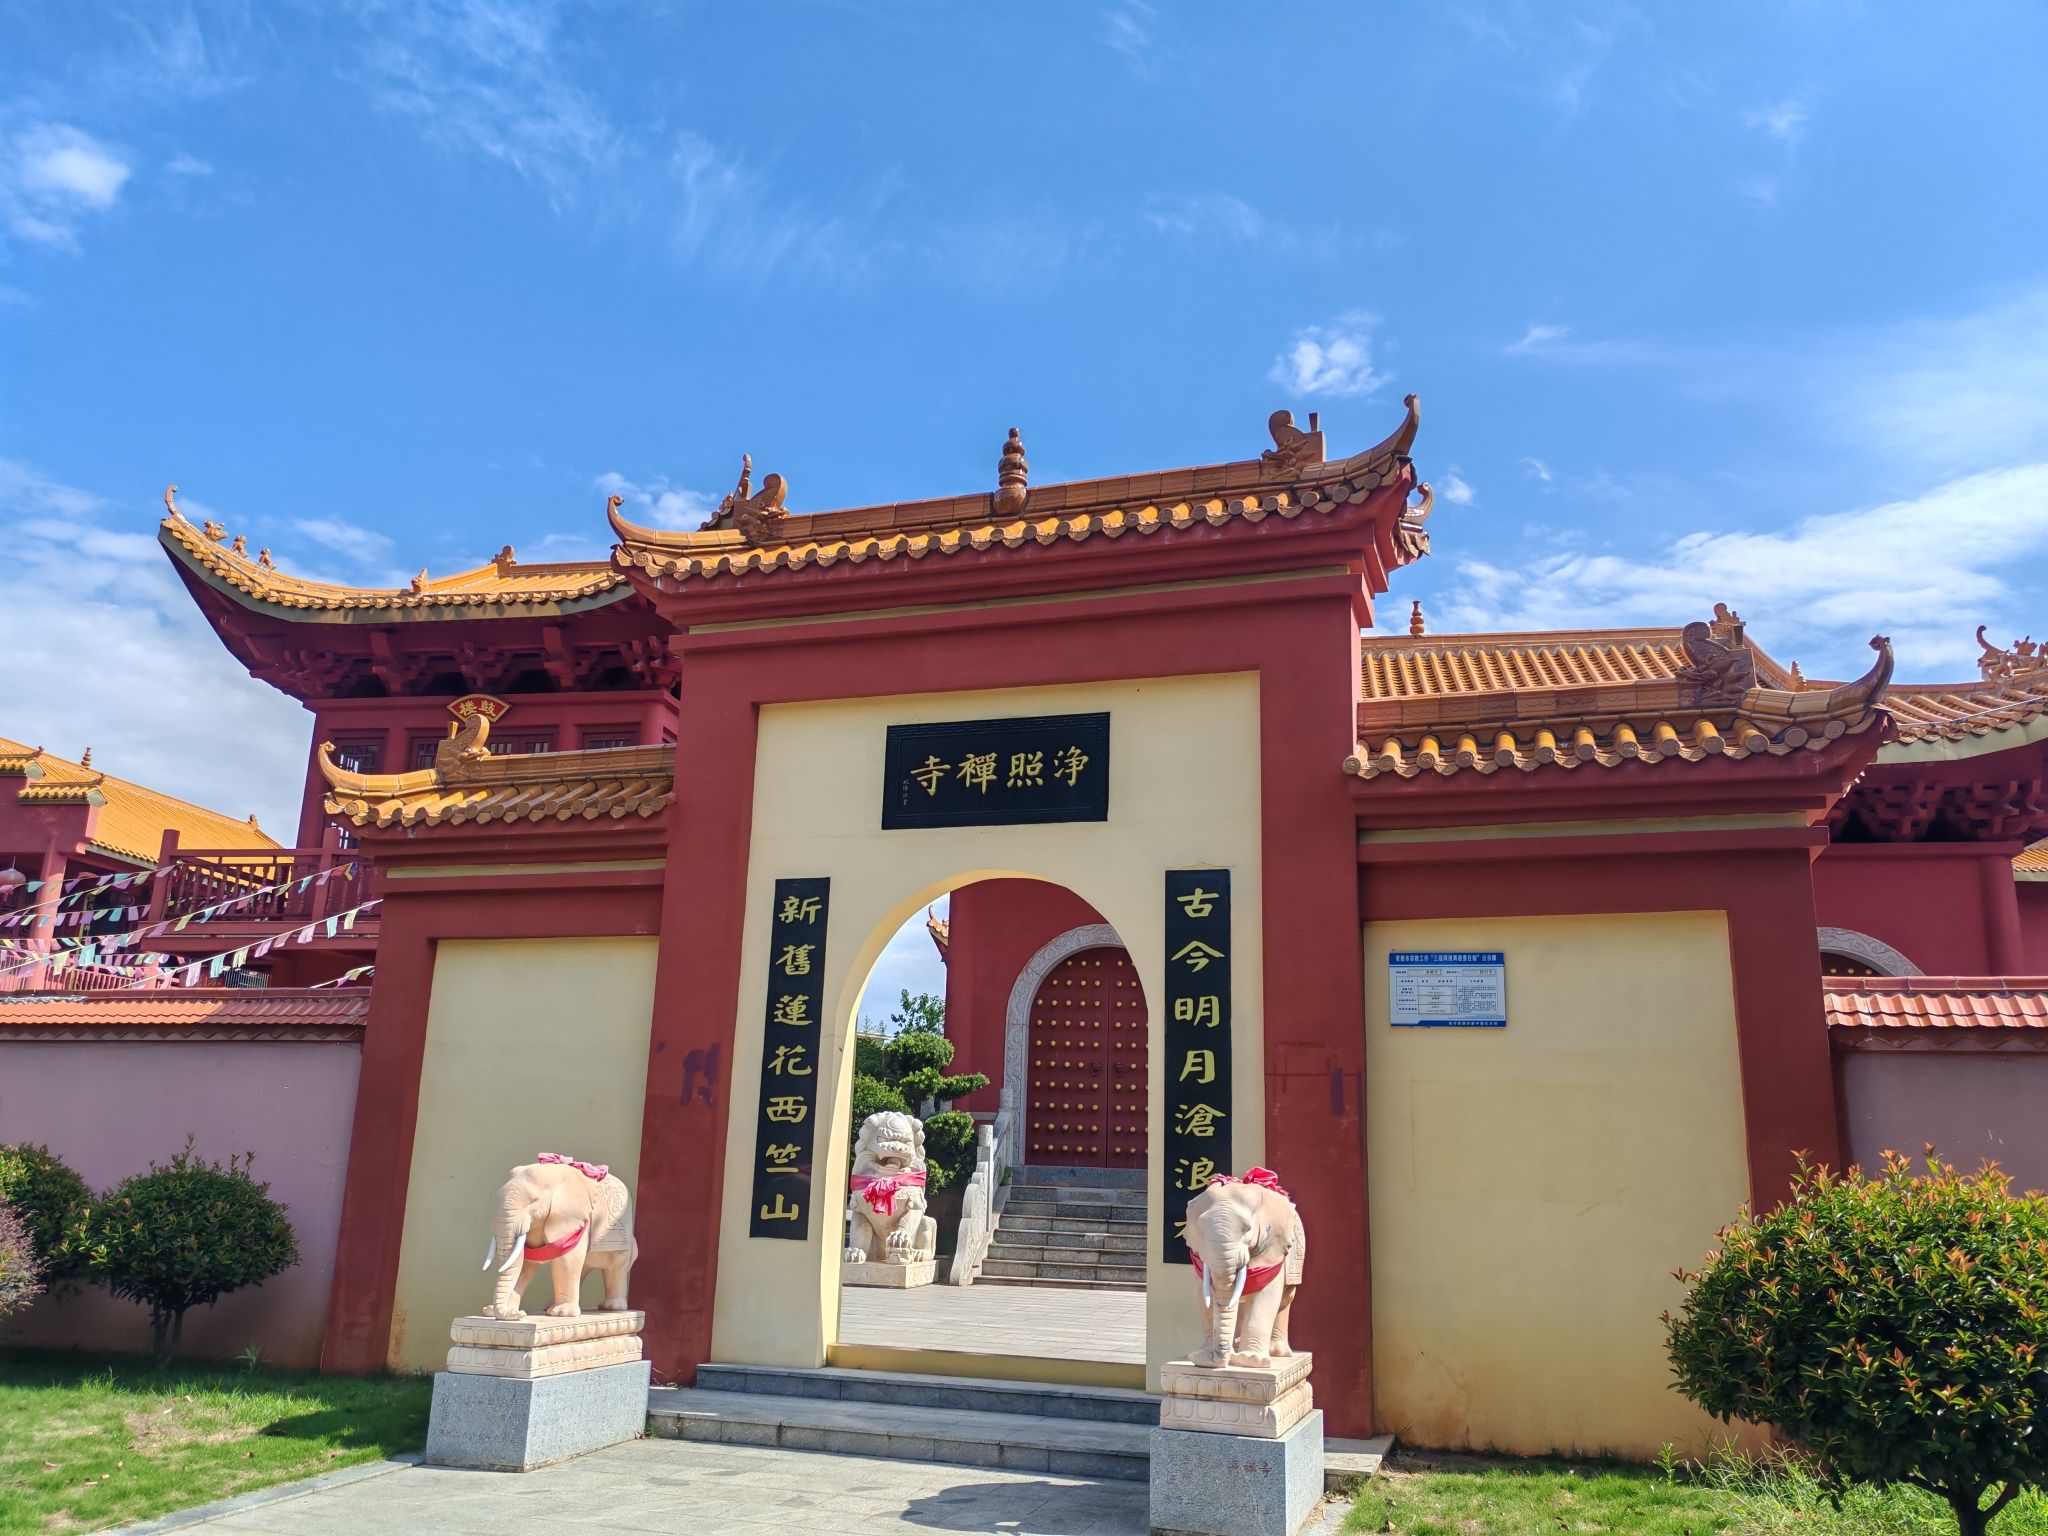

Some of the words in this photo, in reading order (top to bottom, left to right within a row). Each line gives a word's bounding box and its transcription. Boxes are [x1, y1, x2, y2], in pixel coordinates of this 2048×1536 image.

[1170, 887, 1227, 1240] 古今明月滄浪
